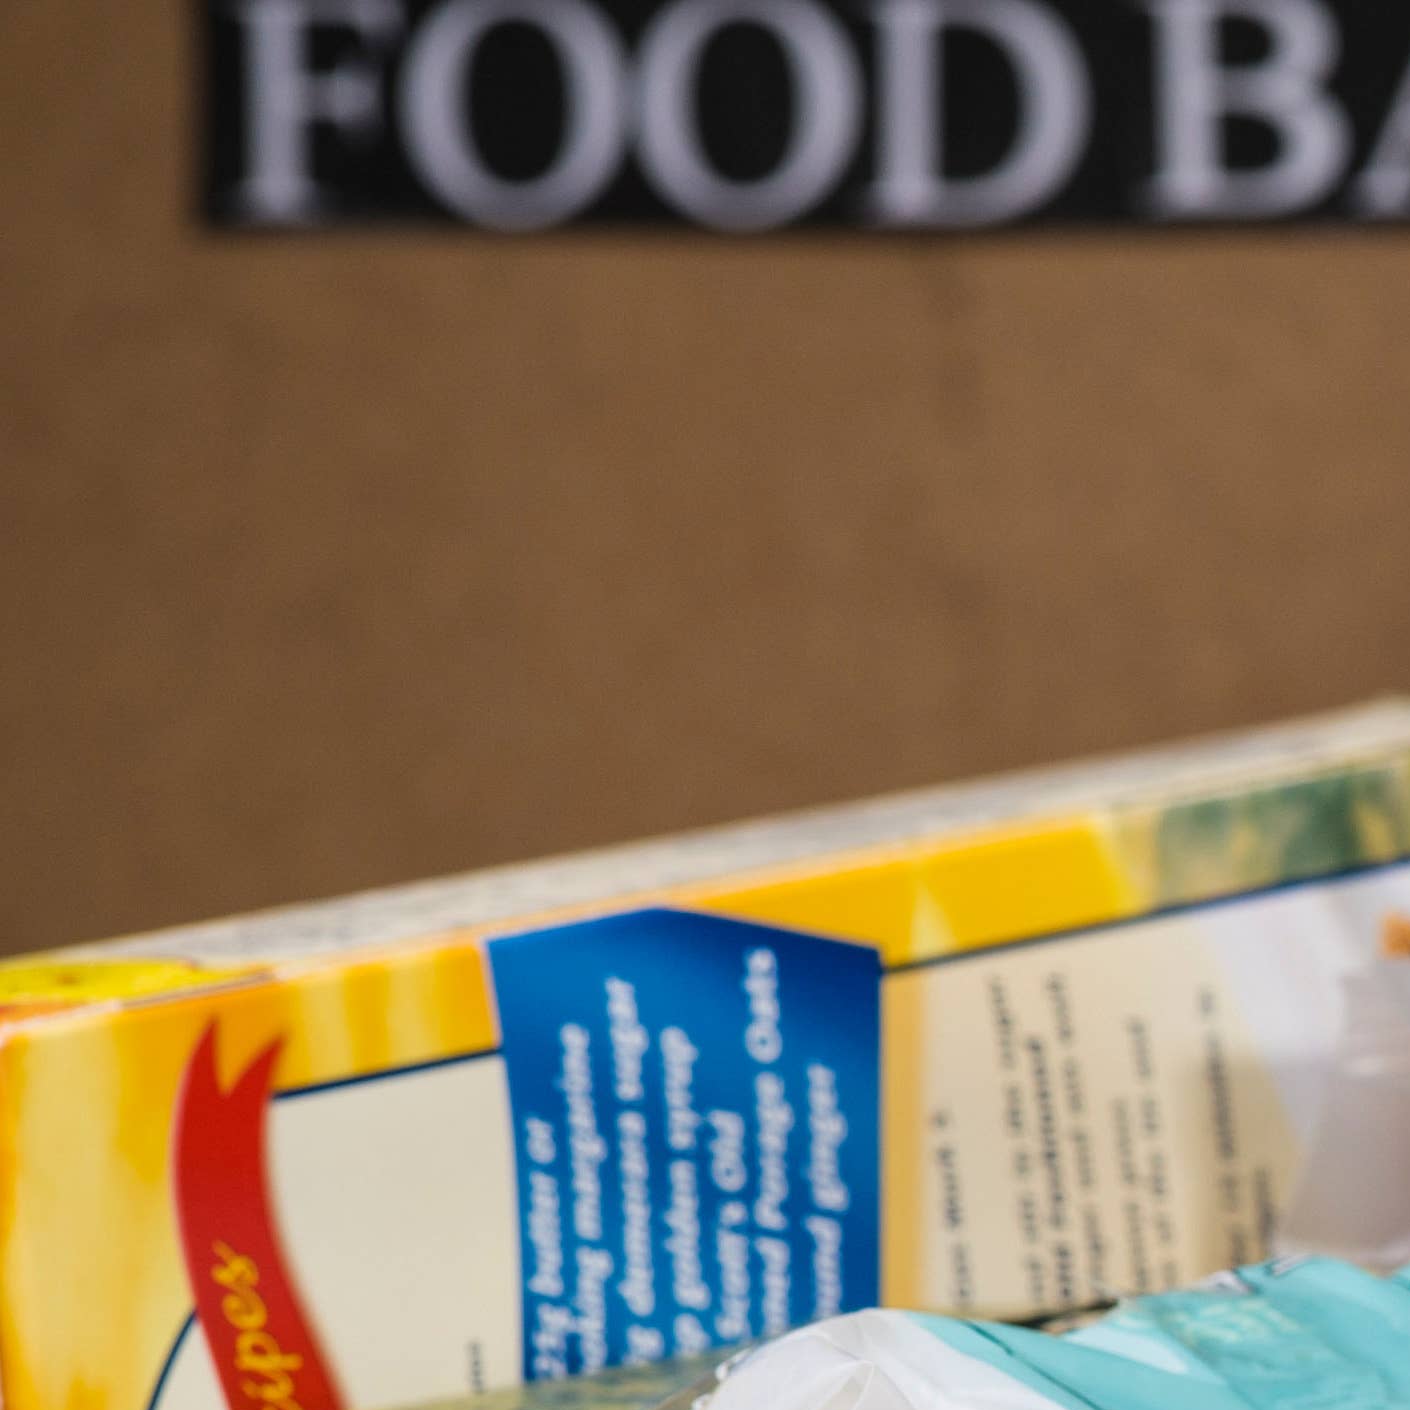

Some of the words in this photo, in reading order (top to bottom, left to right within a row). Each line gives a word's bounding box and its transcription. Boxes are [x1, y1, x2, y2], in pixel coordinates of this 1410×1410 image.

[237, 0, 1090, 231] FOOD
[603, 977, 649, 1101] sugar
[745, 949, 781, 1062] Oats
[559, 1023, 607, 1241] margarine
[660, 1026, 700, 1150] syrup
[806, 1062, 849, 1212] ginger
[665, 1160, 710, 1309] golden
